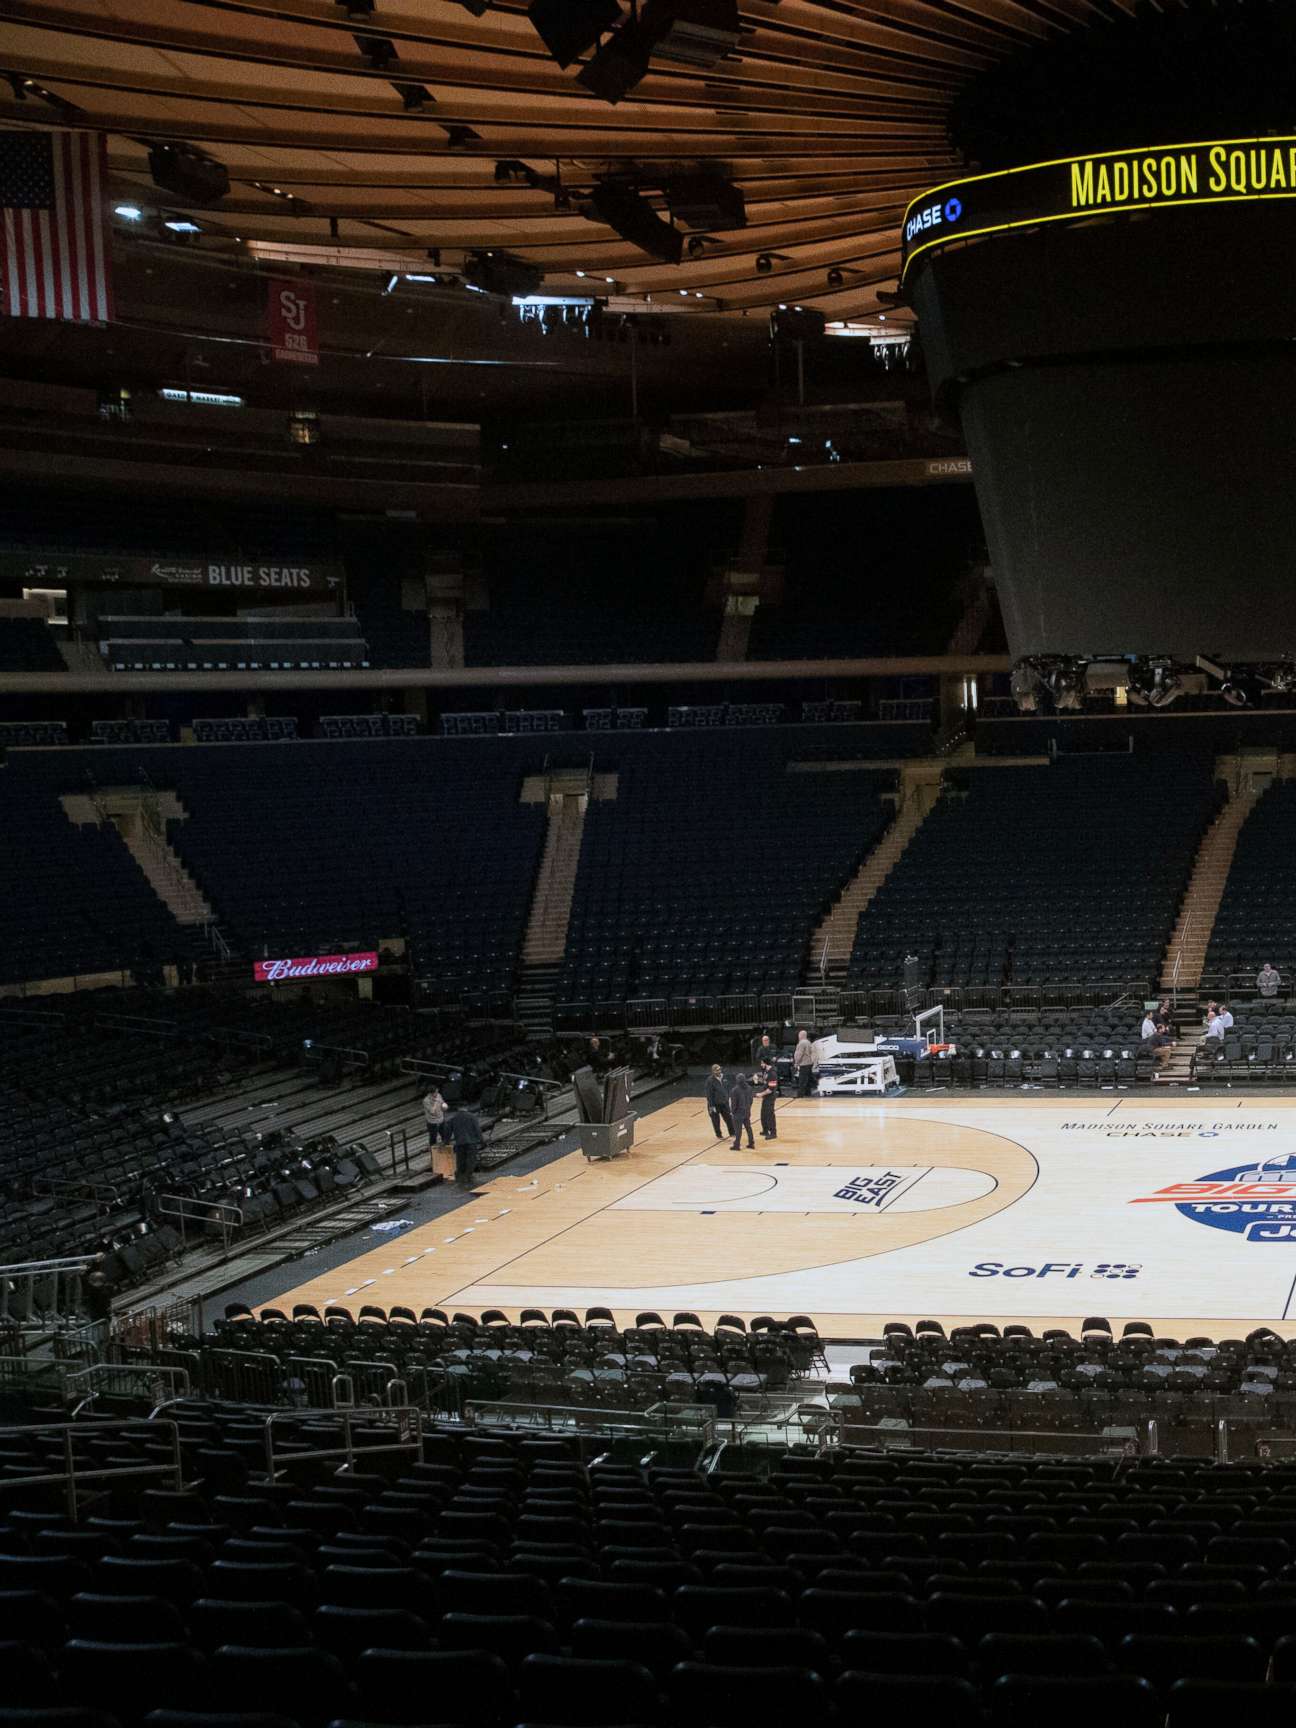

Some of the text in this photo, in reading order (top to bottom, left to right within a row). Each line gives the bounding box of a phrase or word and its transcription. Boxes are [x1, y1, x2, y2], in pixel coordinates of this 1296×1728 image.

[1071, 153, 1198, 208] MADISON
[906, 204, 943, 242] CHASE
[208, 565, 254, 586] BLUE
[259, 567, 311, 588] SEATS
[262, 957, 372, 980] Budweiser
[1060, 1122, 1280, 1130] MADISON SQUARE GARDEN
[833, 1176, 874, 1200] BIG
[853, 1171, 902, 1204] EAST
[968, 1262, 1084, 1279] SoFi
